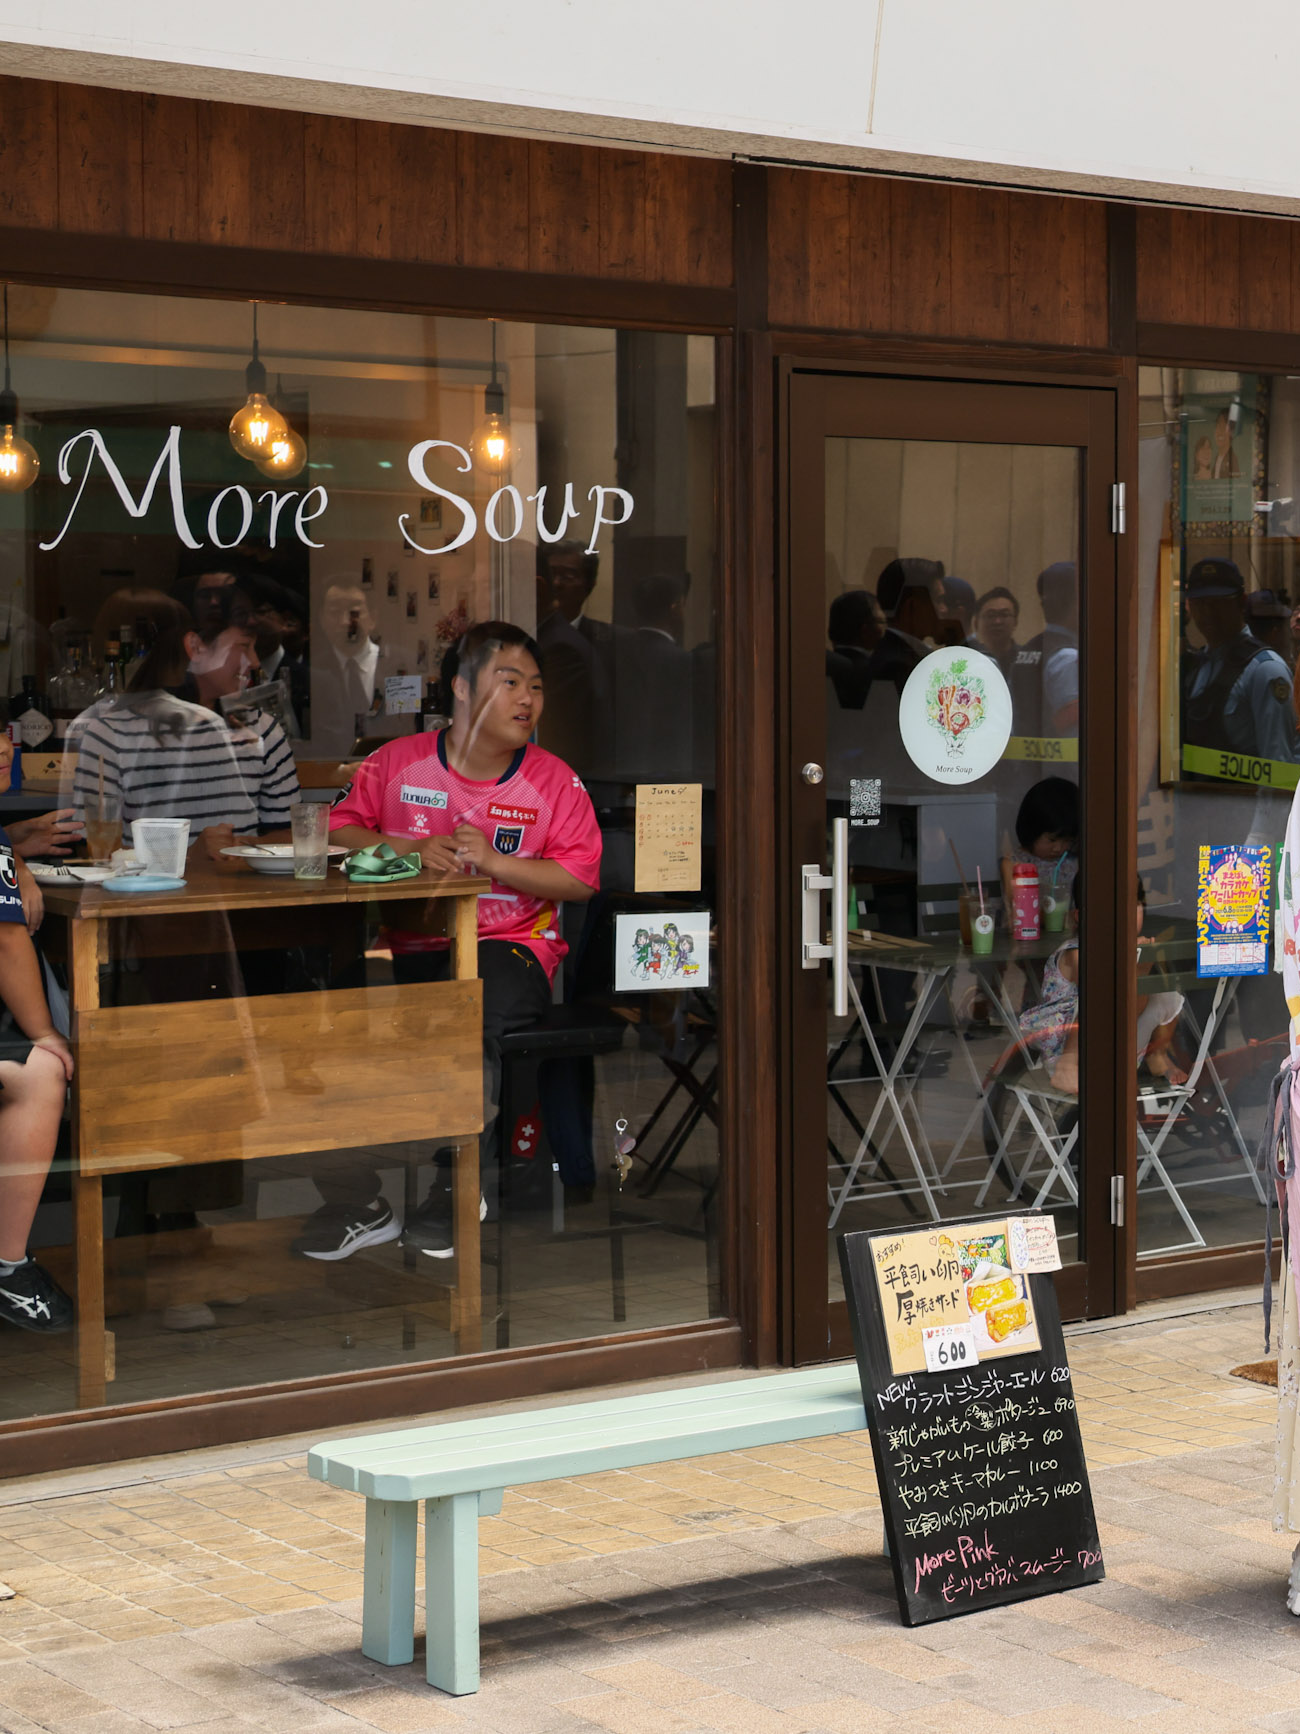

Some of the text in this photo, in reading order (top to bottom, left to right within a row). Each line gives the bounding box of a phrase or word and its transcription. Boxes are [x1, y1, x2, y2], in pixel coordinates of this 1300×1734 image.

[38, 425, 635, 556] More Soup
[936, 765, 973, 775] More Soup
[651, 787, 676, 795] June
[1210, 889, 1259, 899] ワールドカップ
[1220, 880, 1250, 890] カラオケ
[883, 1260, 960, 1291] 平飼い卵
[895, 1288, 961, 1325] 厚焼きサンド
[938, 1341, 966, 1365] 600
[905, 1366, 1070, 1414] クラフトジンジャーエール 620
[898, 1459, 1058, 1510] やみつきキーマカレー 1100
[1053, 1481, 1082, 1499] 1400
[914, 1528, 999, 1594] More Pink
[1077, 1550, 1101, 1569] 700
